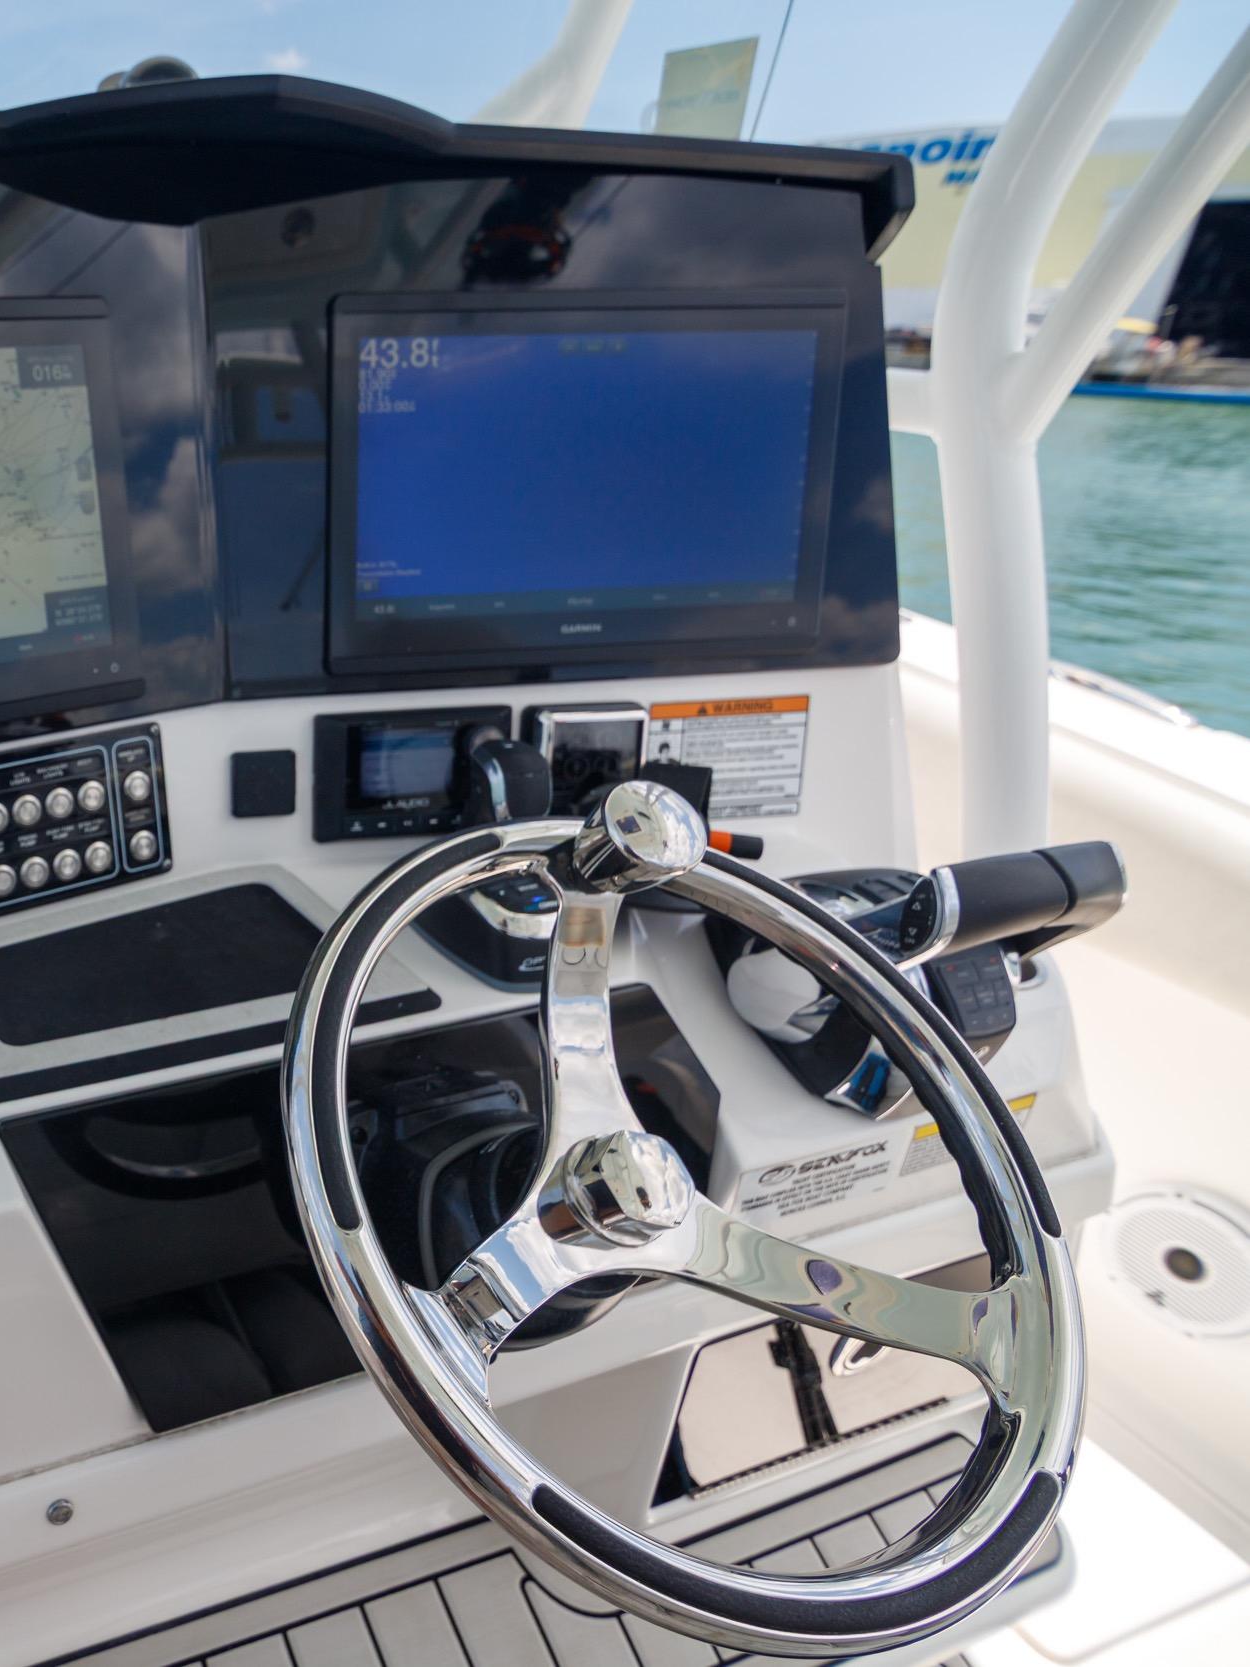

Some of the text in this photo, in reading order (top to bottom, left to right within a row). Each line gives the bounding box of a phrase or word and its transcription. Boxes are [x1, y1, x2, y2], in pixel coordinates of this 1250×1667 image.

[360, 338, 429, 368] 43.8
[560, 624, 603, 635] GARMIN
[713, 701, 774, 712] WARNING
